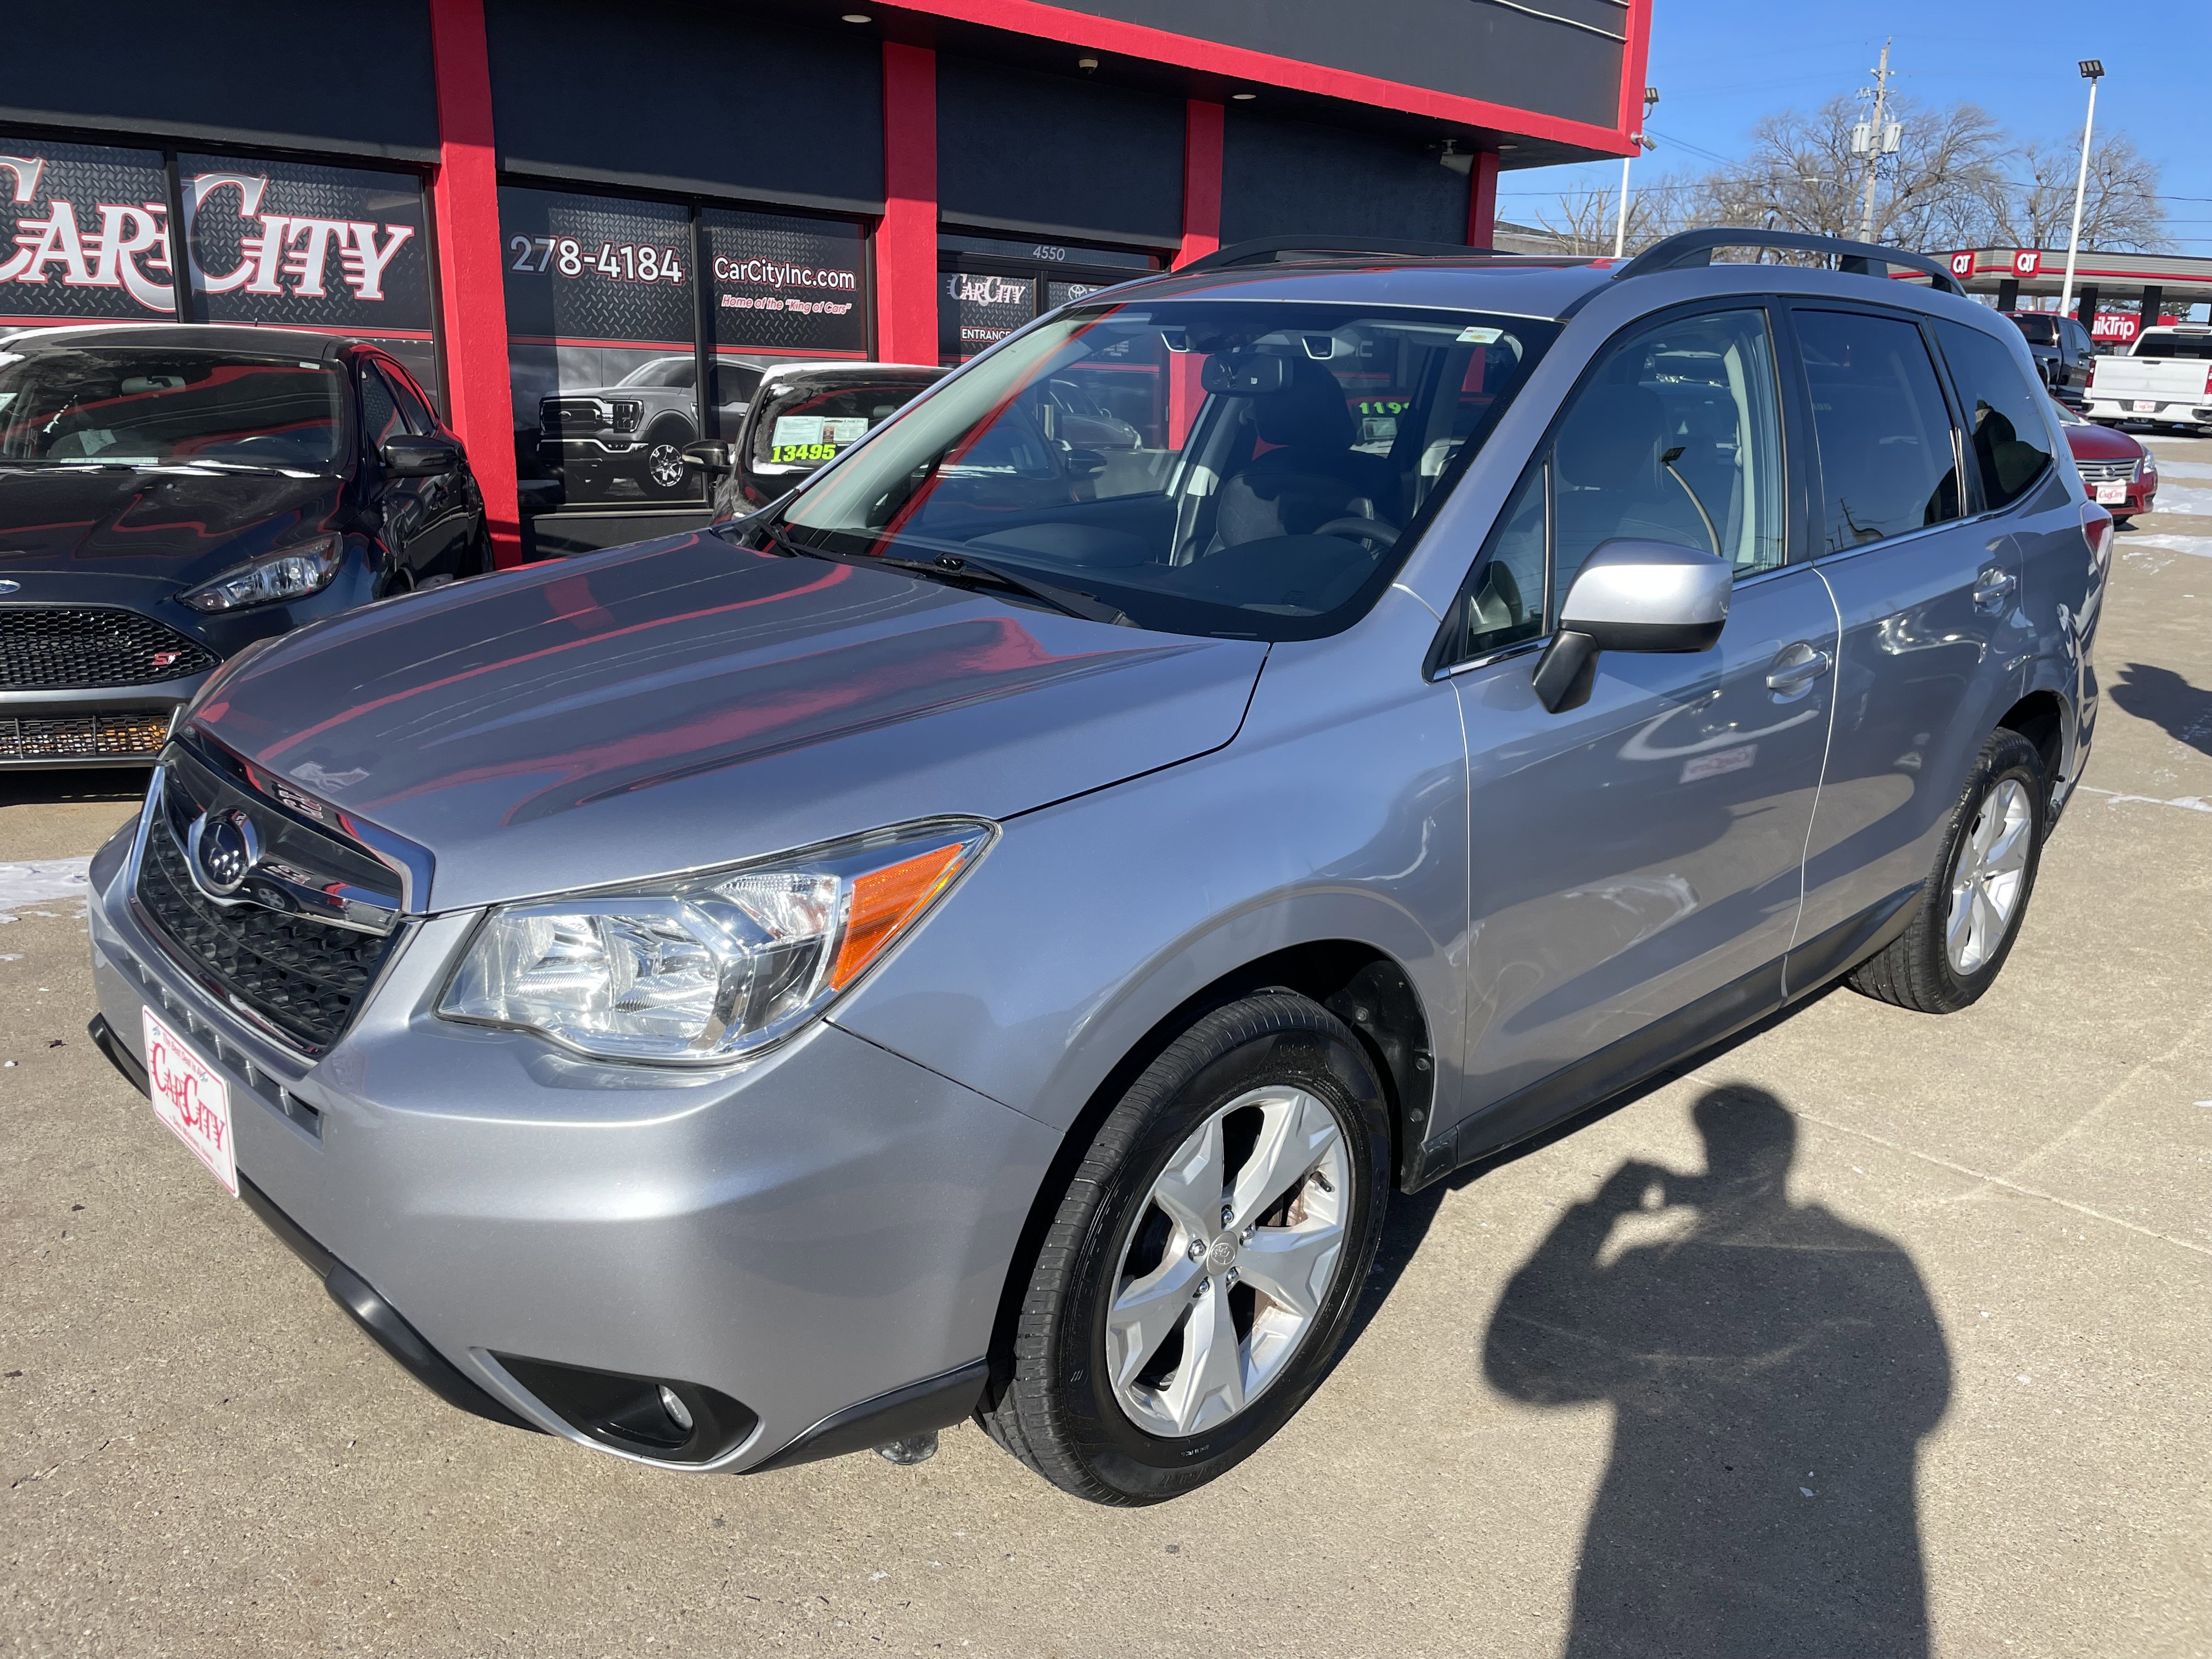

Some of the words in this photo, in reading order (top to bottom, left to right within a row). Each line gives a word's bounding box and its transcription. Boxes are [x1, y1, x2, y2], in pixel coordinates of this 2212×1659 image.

[510, 235, 682, 283] 278-4184
[1032, 245, 1065, 261] 4550
[2017, 253, 2038, 273] QT
[714, 257, 855, 289] CarCityInc.com
[1953, 254, 1972, 274] QT
[721, 295, 753, 308] Home
[754, 297, 767, 309] of
[766, 297, 783, 310] the
[812, 301, 825, 313] of
[2091, 316, 2135, 340] uikTrip
[771, 443, 837, 463] 13495
[151, 652, 182, 665] ST
